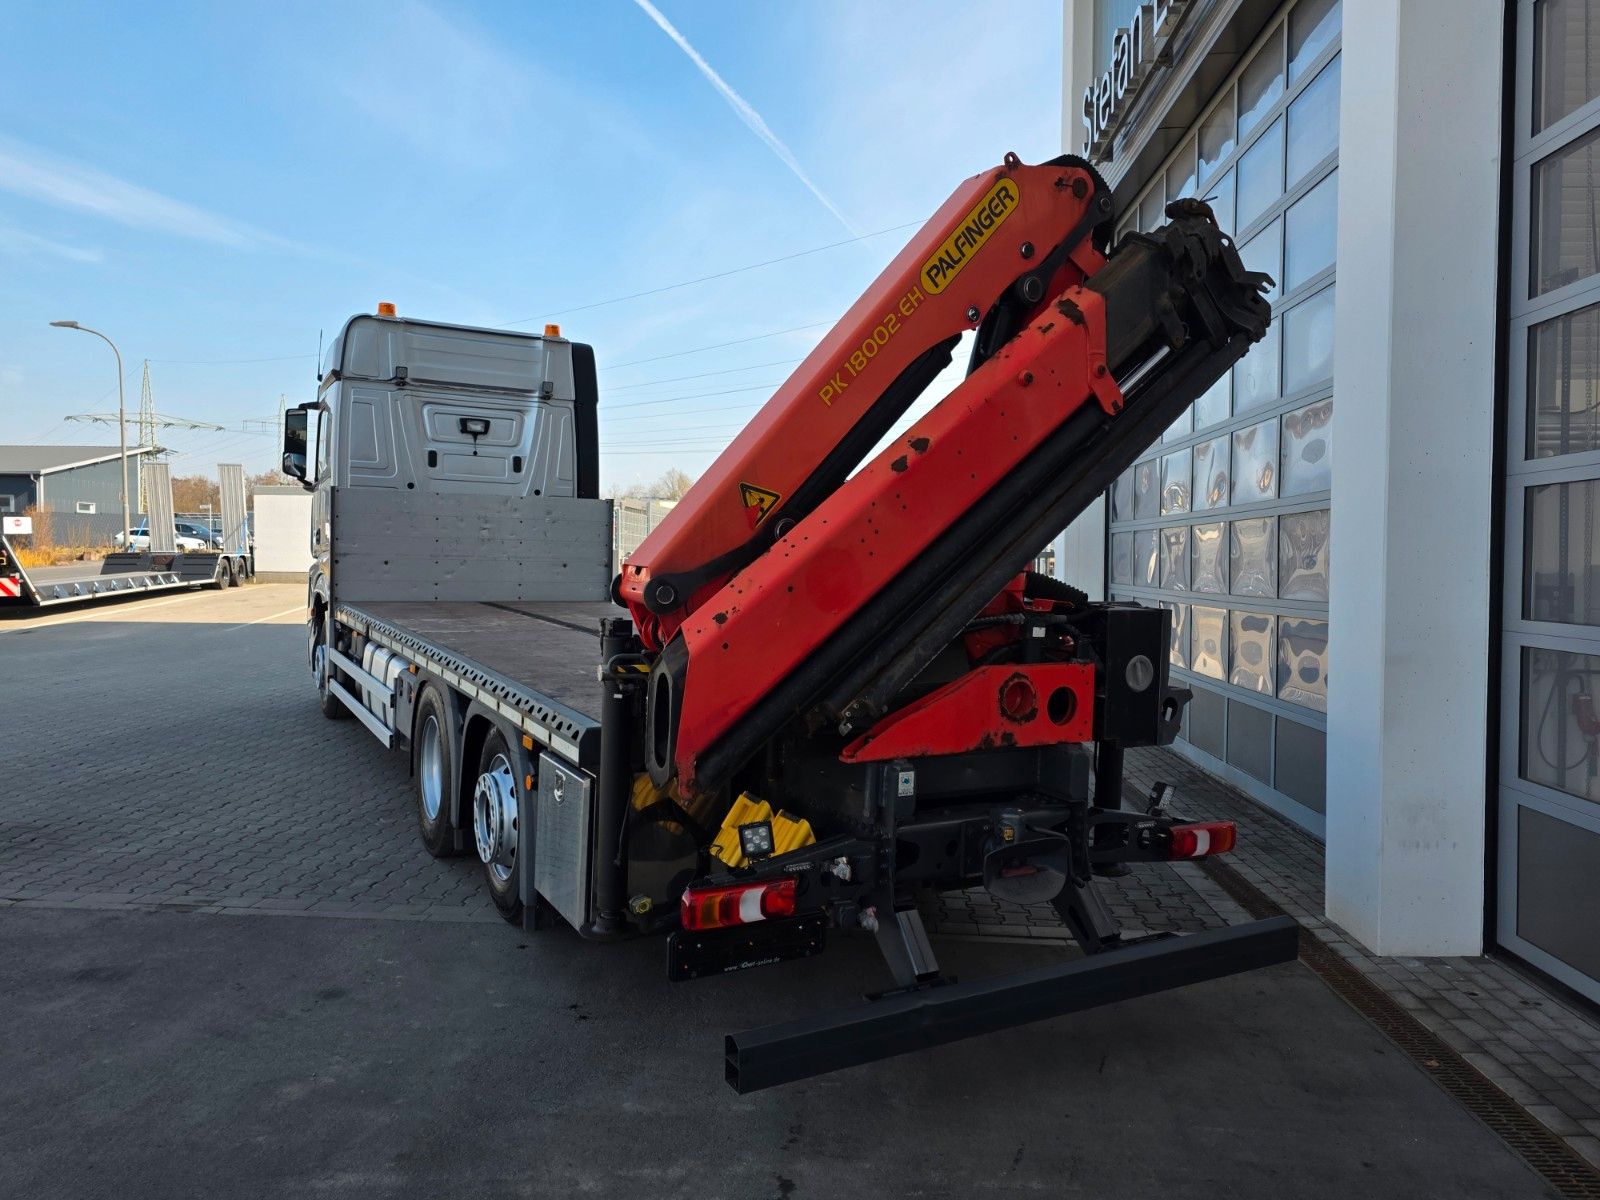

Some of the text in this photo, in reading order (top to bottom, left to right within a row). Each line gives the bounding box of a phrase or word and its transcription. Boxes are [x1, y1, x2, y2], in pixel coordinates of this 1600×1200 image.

[1082, 5, 1143, 160] Stefan
[926, 186, 1014, 288] PALFINGER
[819, 372, 848, 406] PK
